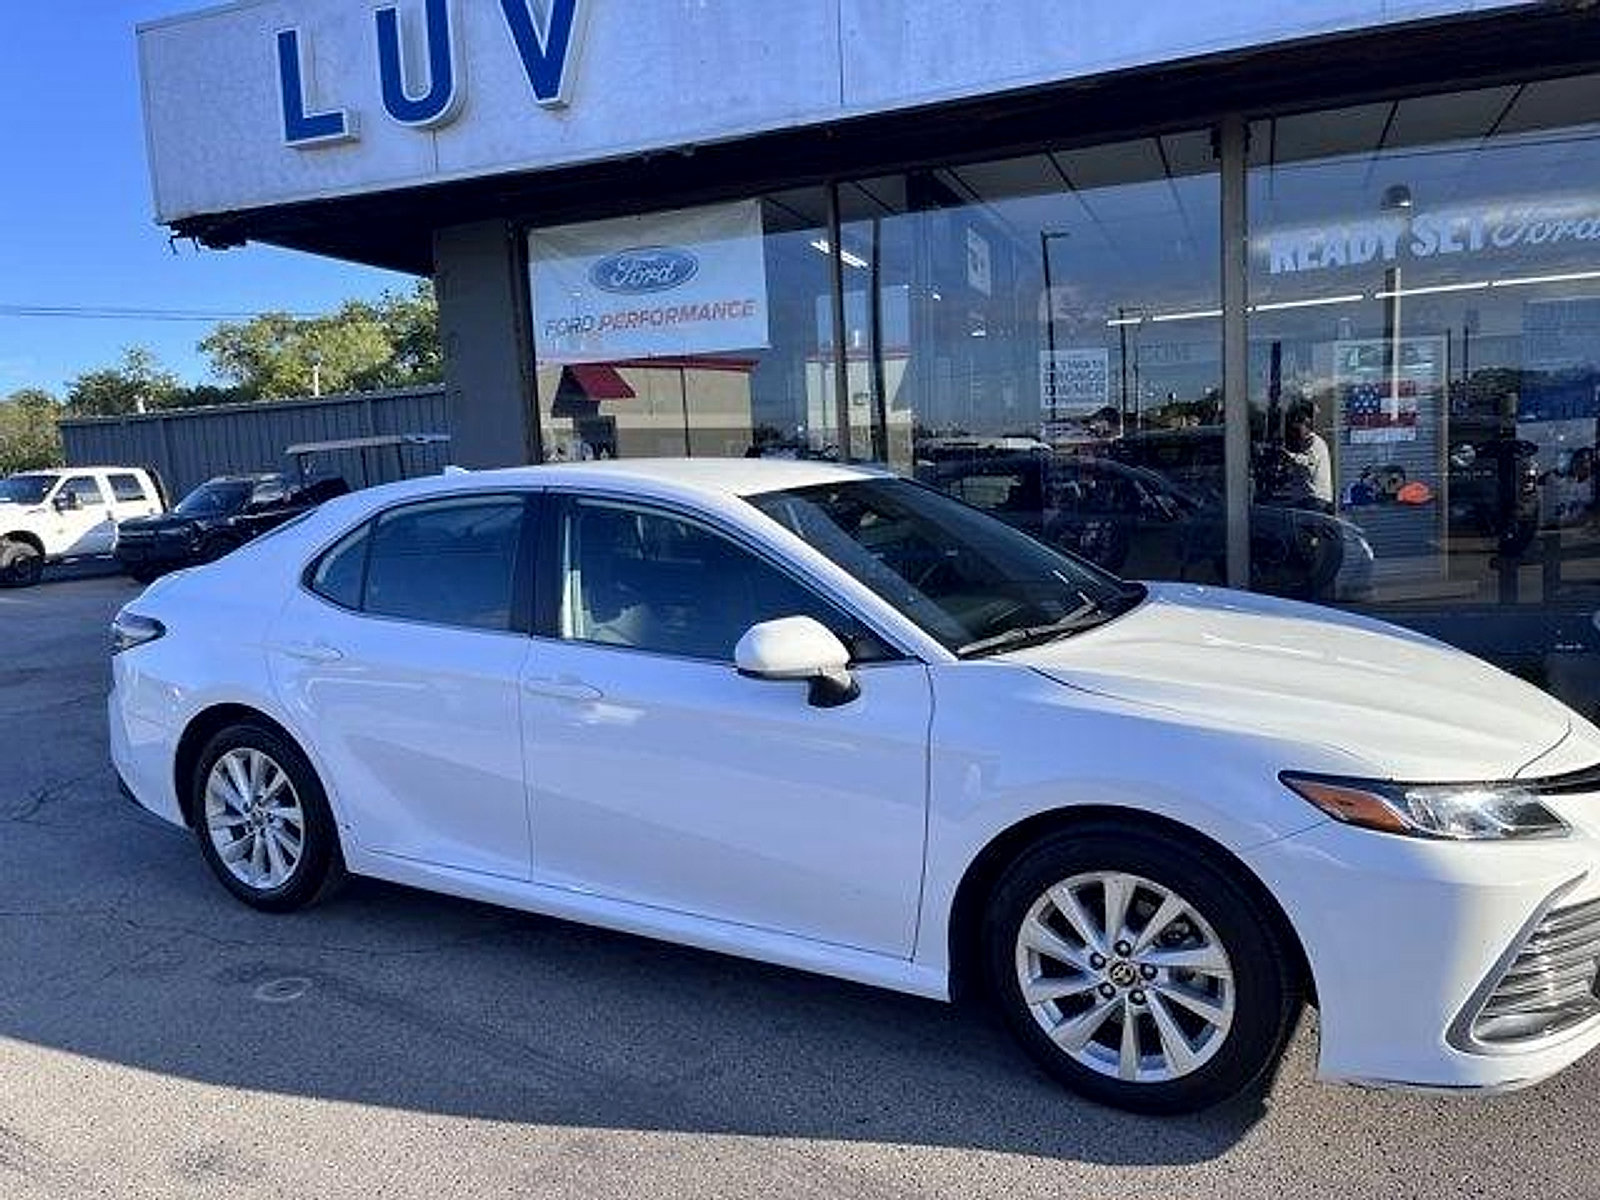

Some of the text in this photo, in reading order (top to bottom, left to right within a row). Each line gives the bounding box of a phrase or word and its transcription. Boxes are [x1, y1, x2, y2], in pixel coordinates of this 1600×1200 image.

[277, 0, 580, 147] LUV
[1269, 217, 1402, 274] READY
[1409, 210, 1484, 257] SET
[611, 254, 676, 286] Ford
[544, 300, 757, 337] FORD PERFORMANCE
